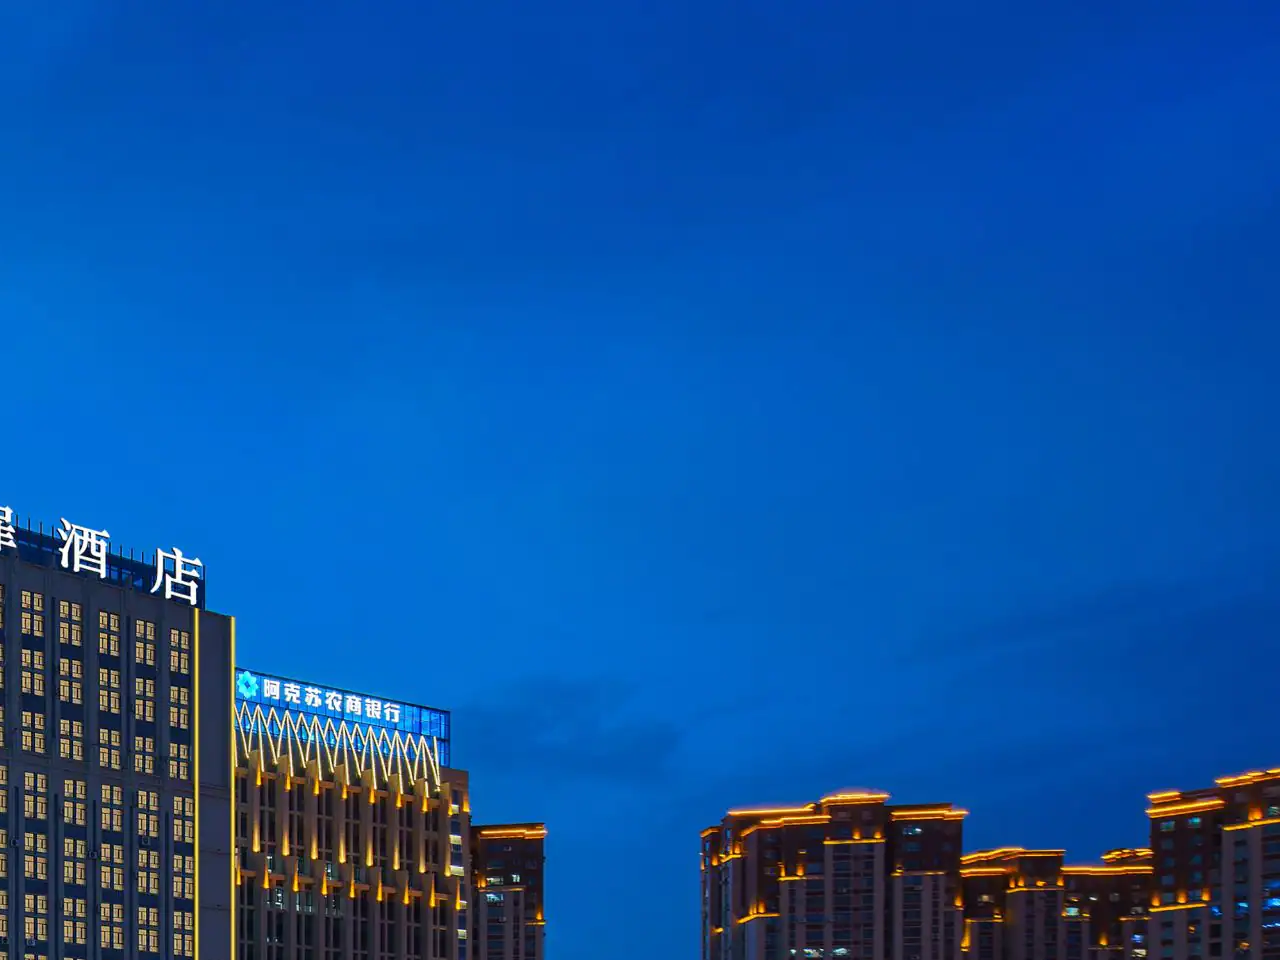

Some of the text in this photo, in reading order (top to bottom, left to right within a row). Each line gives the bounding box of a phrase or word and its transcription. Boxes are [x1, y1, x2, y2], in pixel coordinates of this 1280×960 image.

[263, 679, 401, 723] 阿克苏农商银行
